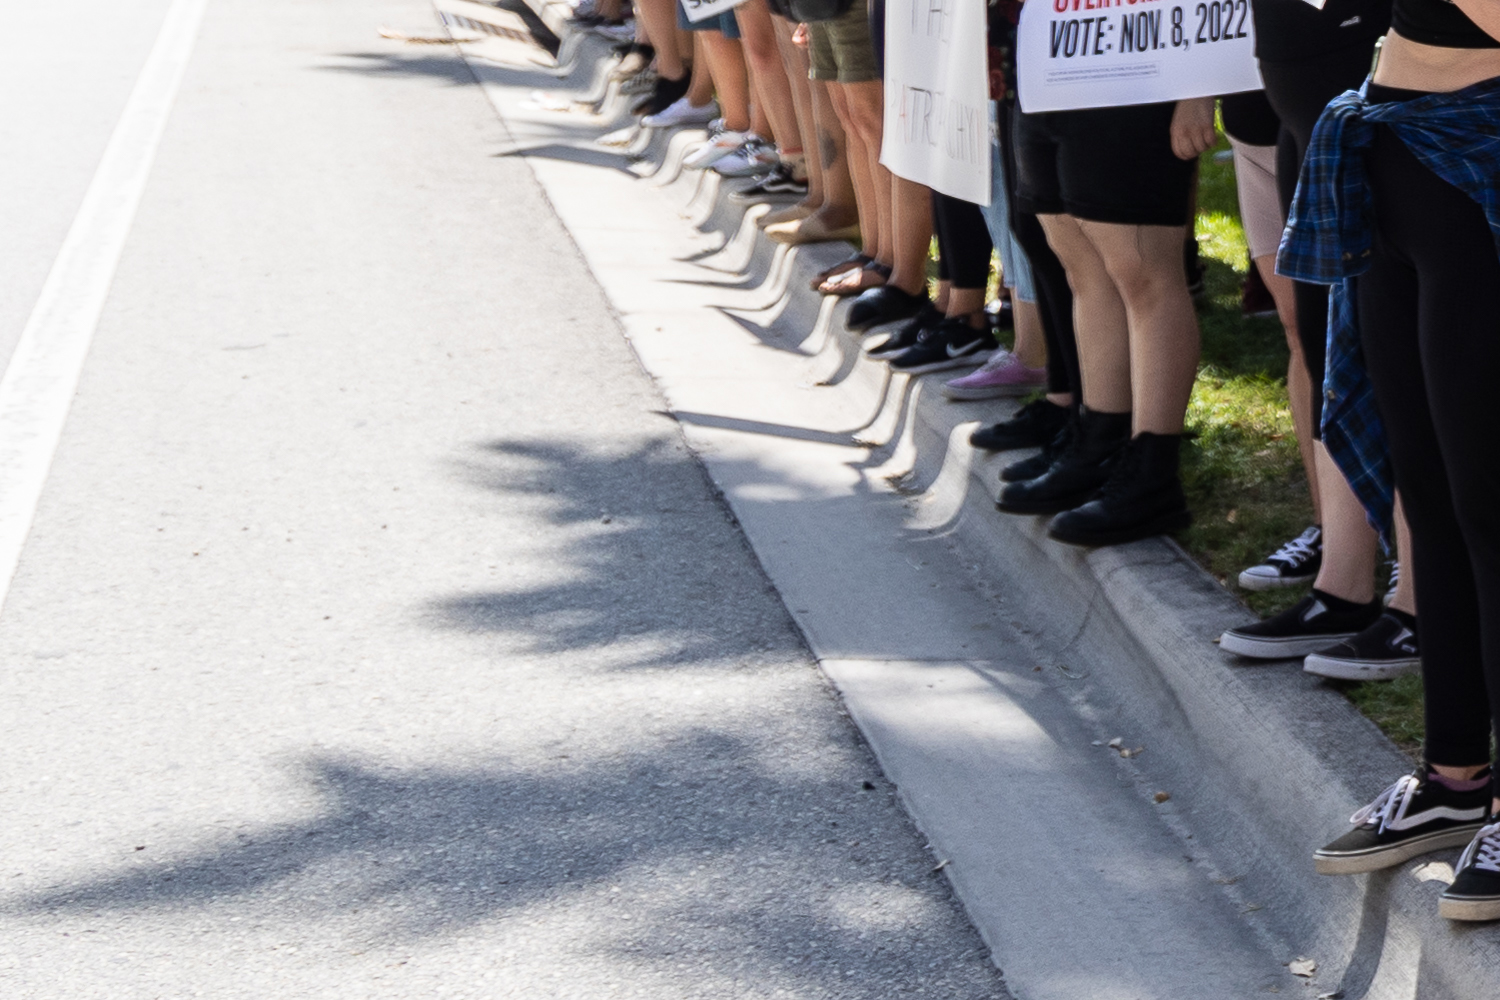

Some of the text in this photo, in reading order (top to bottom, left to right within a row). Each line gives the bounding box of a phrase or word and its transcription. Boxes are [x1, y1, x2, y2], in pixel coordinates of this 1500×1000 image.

[1049, 16, 1114, 59] VOTE:
[1119, 9, 1165, 53] NOV.
[1170, 5, 1191, 51] 8,
